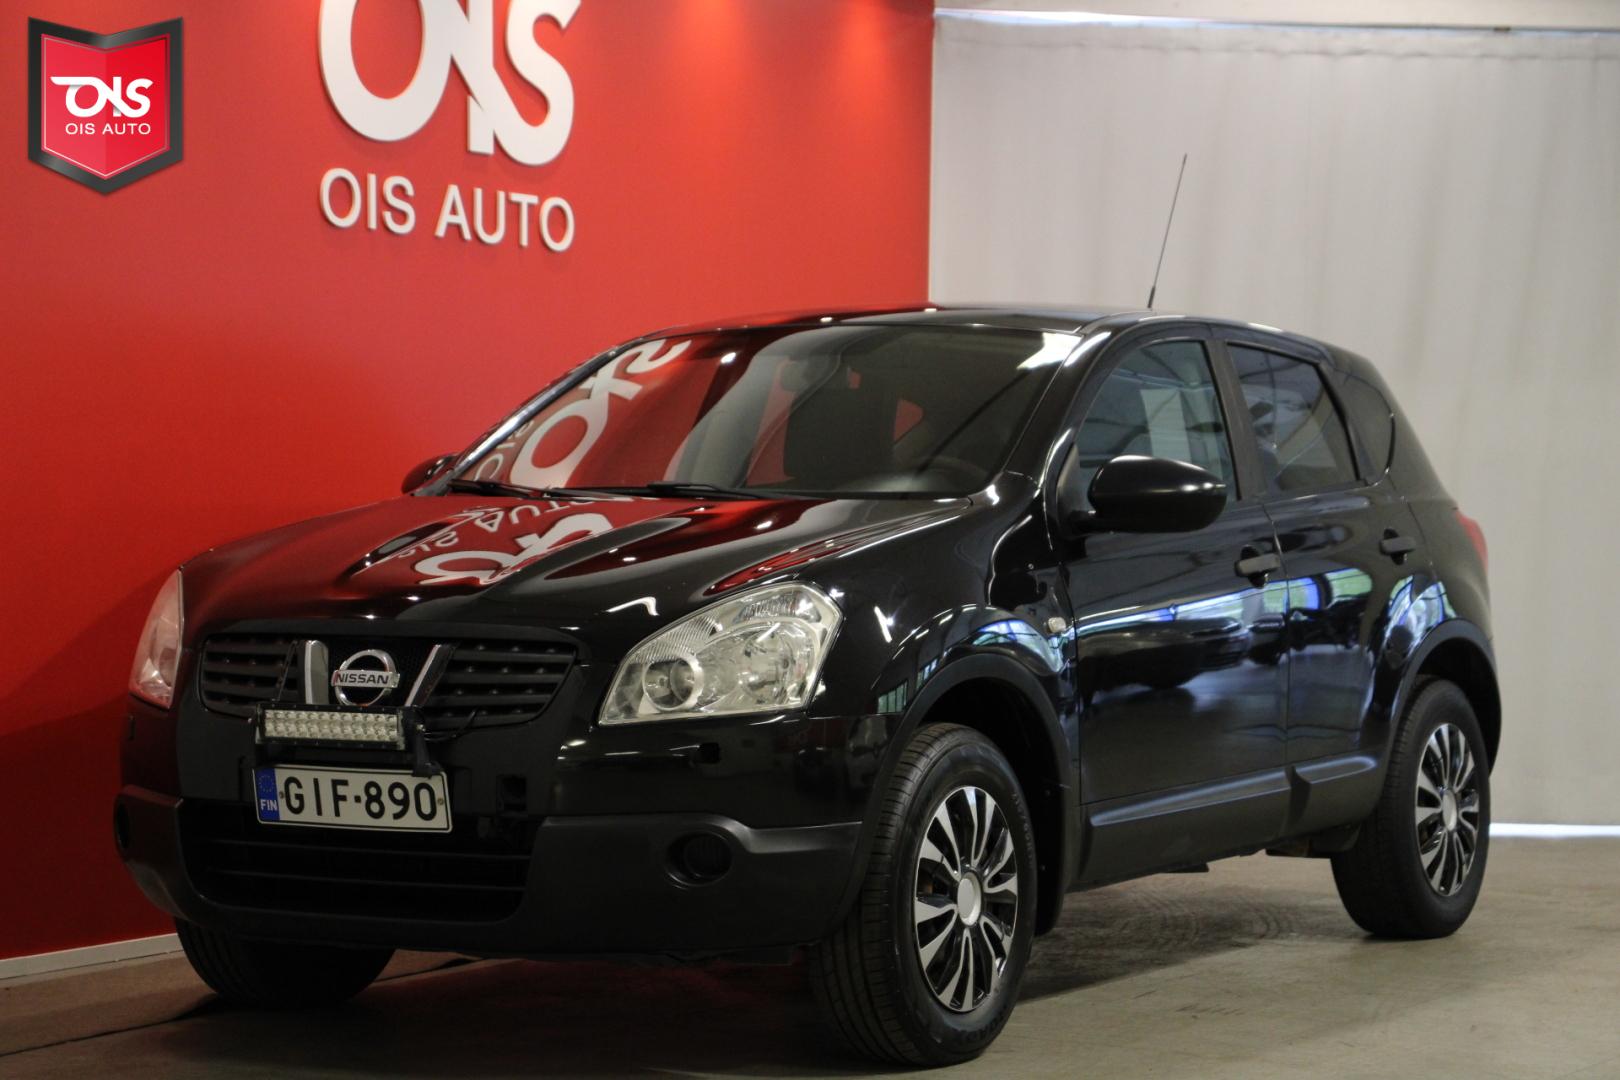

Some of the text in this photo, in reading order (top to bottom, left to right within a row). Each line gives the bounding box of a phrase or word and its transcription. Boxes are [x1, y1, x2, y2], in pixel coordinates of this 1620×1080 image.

[319, 167, 575, 252] OIS AUTO
[336, 673, 389, 685] NISSAN
[260, 799, 278, 811] FIN
[284, 776, 438, 821] GIF-890
